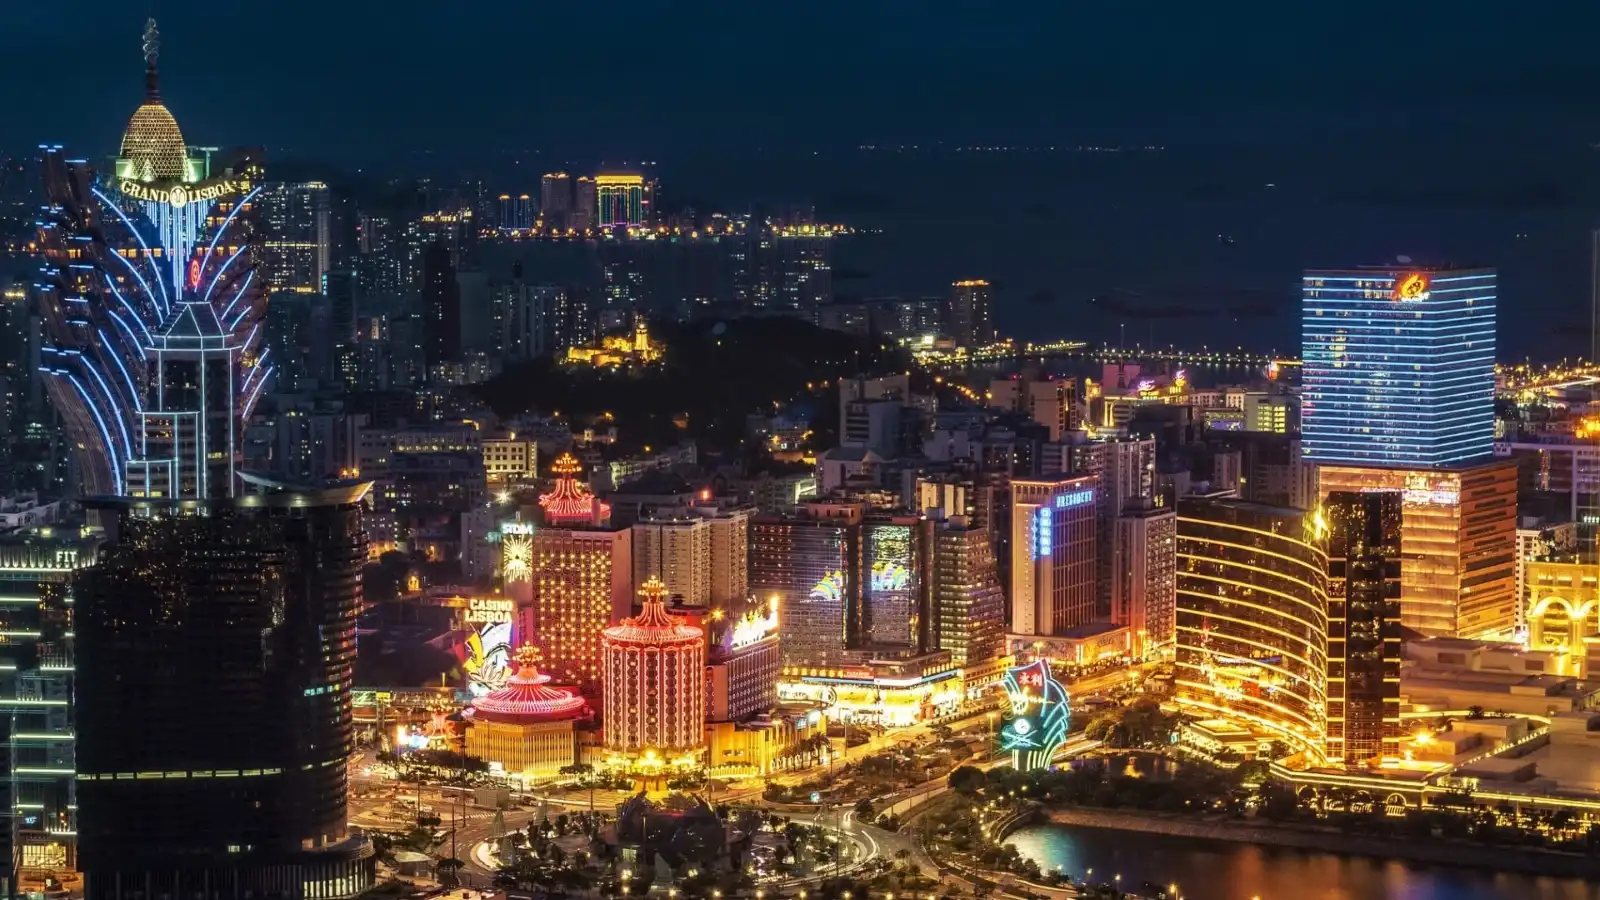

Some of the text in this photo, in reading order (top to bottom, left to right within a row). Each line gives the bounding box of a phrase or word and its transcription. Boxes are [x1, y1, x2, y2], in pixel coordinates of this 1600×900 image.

[119, 180, 235, 203] GRAND LISBOA
[56, 551, 77, 563] FIT
[470, 599, 513, 611] CASINO
[465, 609, 512, 622] LISBOA
[1019, 672, 1042, 687] 永利
